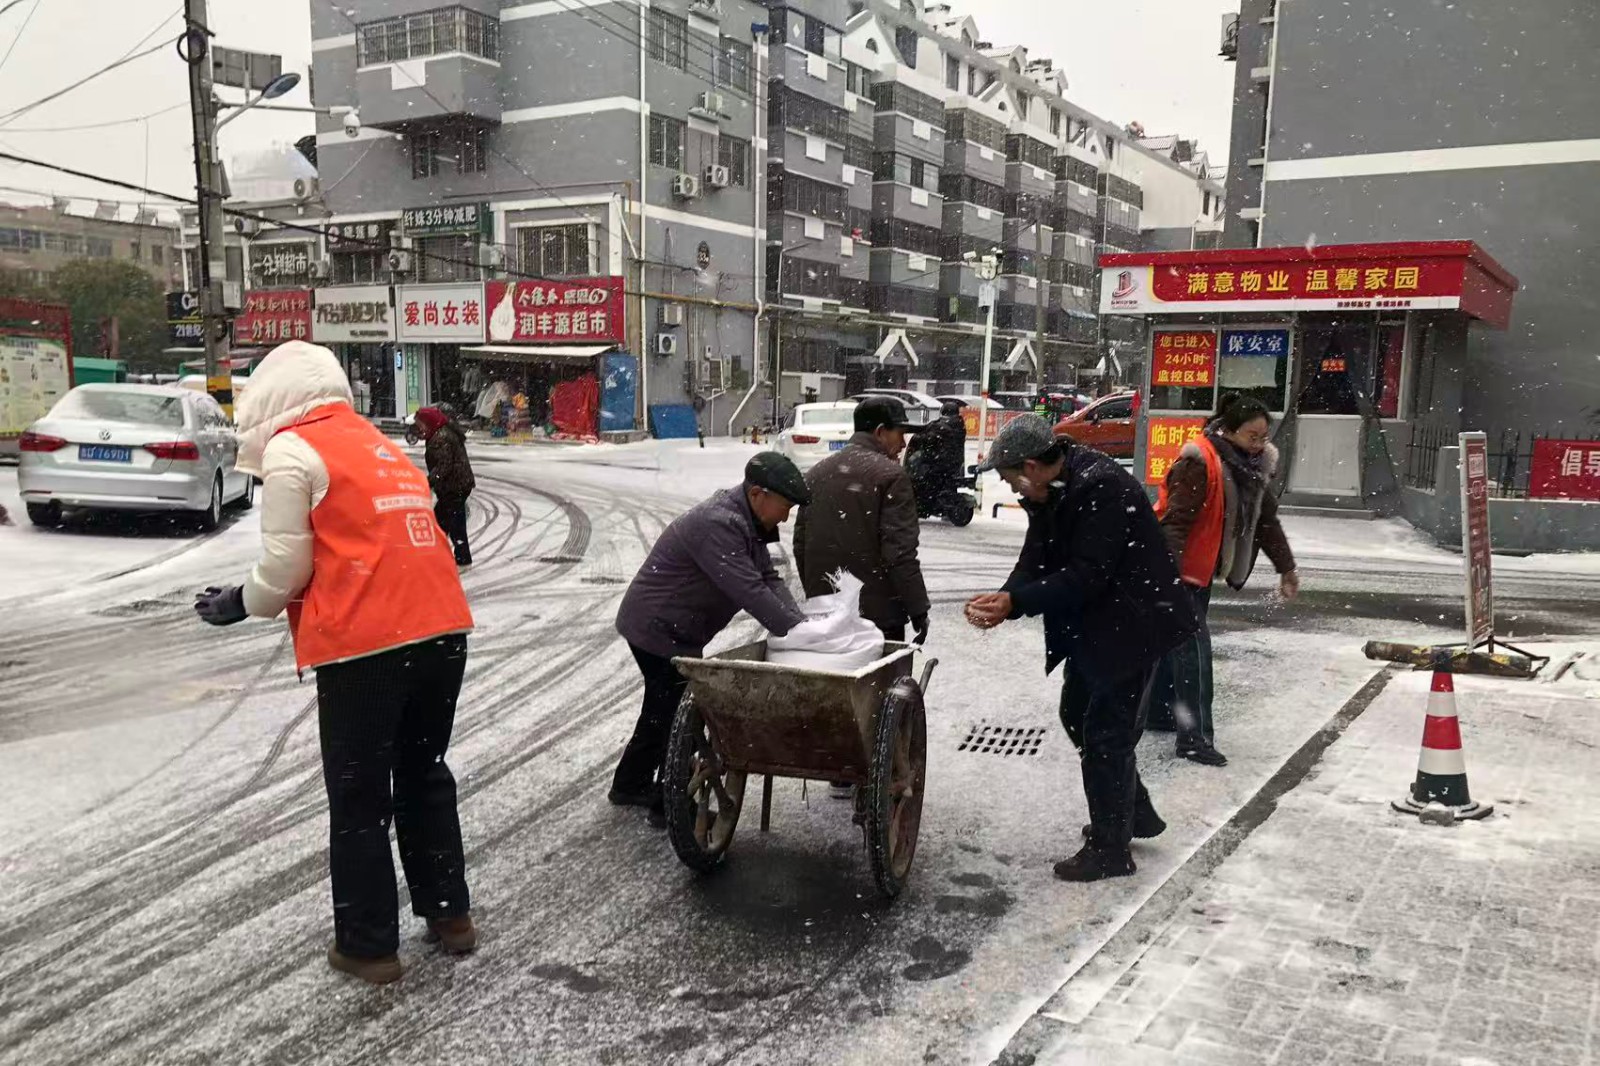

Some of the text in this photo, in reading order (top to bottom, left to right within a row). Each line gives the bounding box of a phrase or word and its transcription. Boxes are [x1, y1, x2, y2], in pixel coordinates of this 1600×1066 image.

[1187, 267, 1420, 294] 满意物业 温馨家园
[404, 300, 480, 326] 爱尚女装
[236, 318, 307, 339] 一分利超市
[519, 311, 607, 336] 润丰源超市
[1159, 335, 1211, 348] 您已进入
[1228, 334, 1283, 352] 保安室
[1165, 353, 1206, 366] 24小时
[1157, 369, 1209, 384] 监控区域
